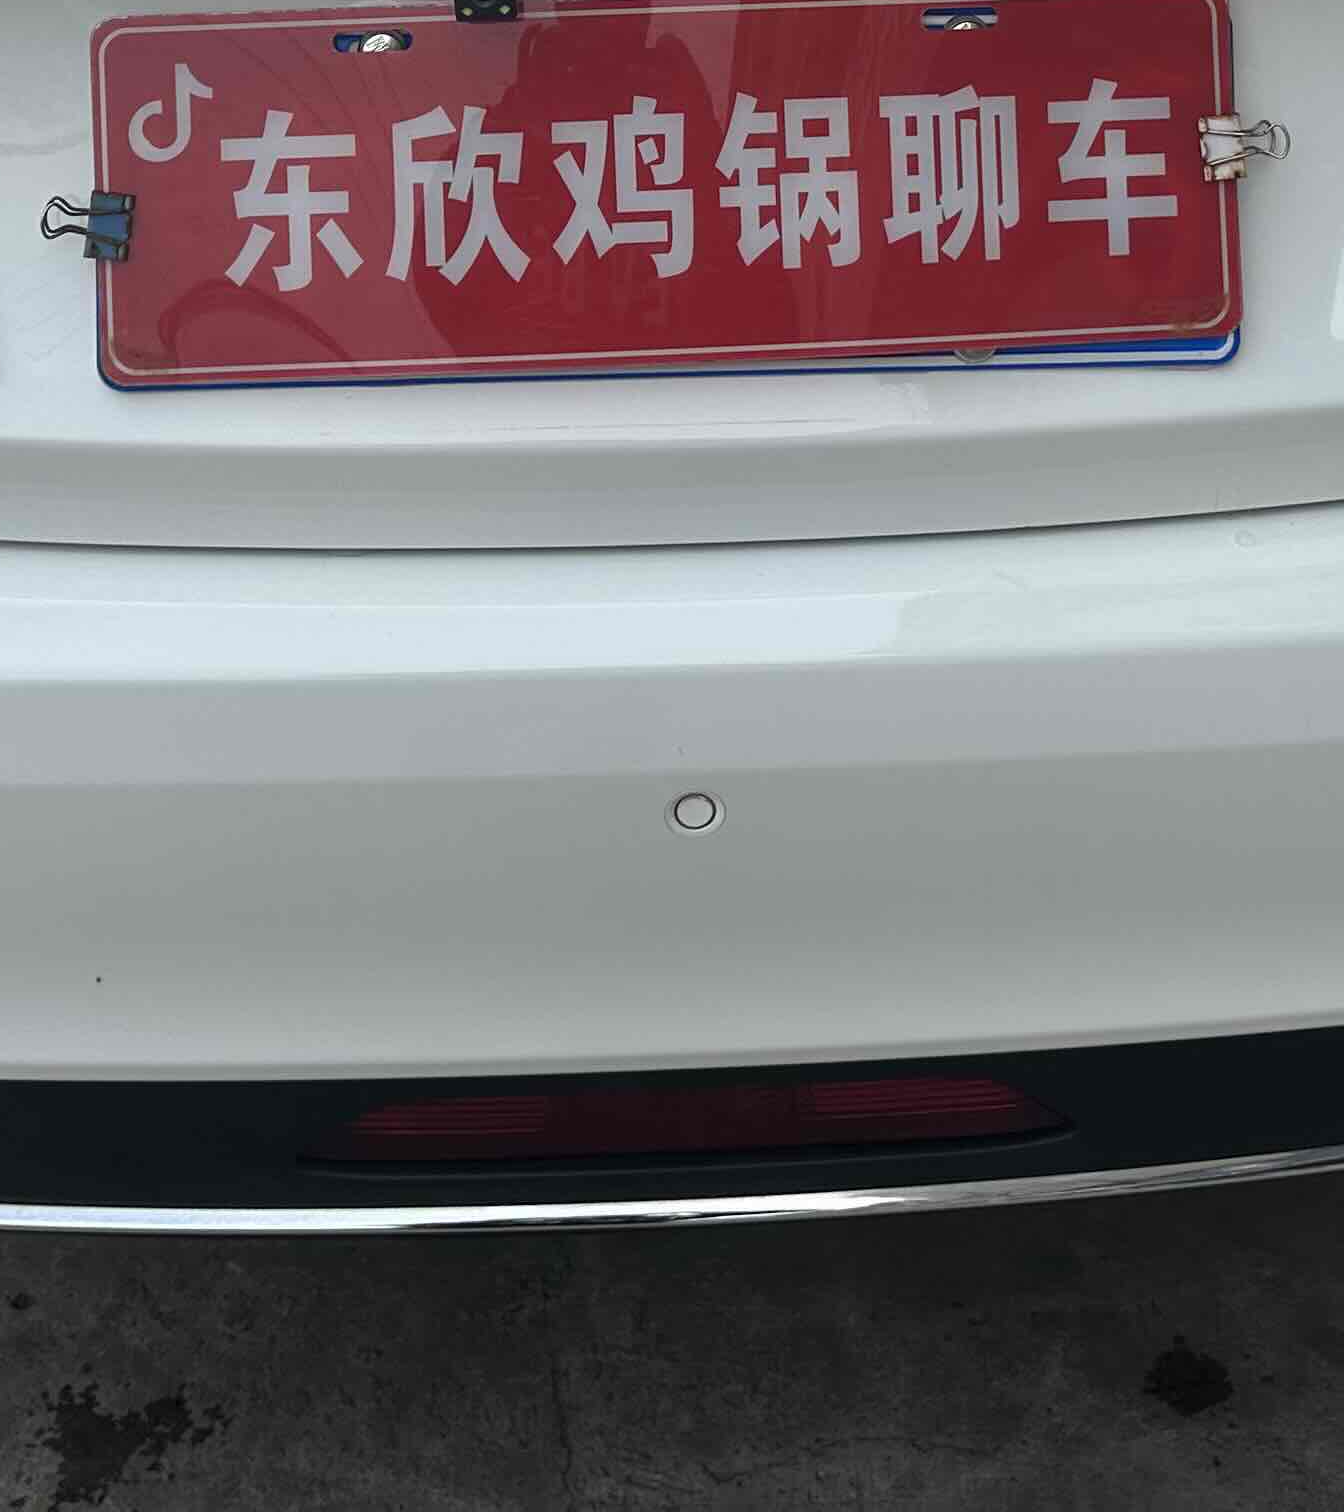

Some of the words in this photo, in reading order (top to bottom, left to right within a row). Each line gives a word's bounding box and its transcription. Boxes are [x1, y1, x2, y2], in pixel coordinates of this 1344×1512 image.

[218, 76, 1179, 292] 东欣鸡锅聊车
